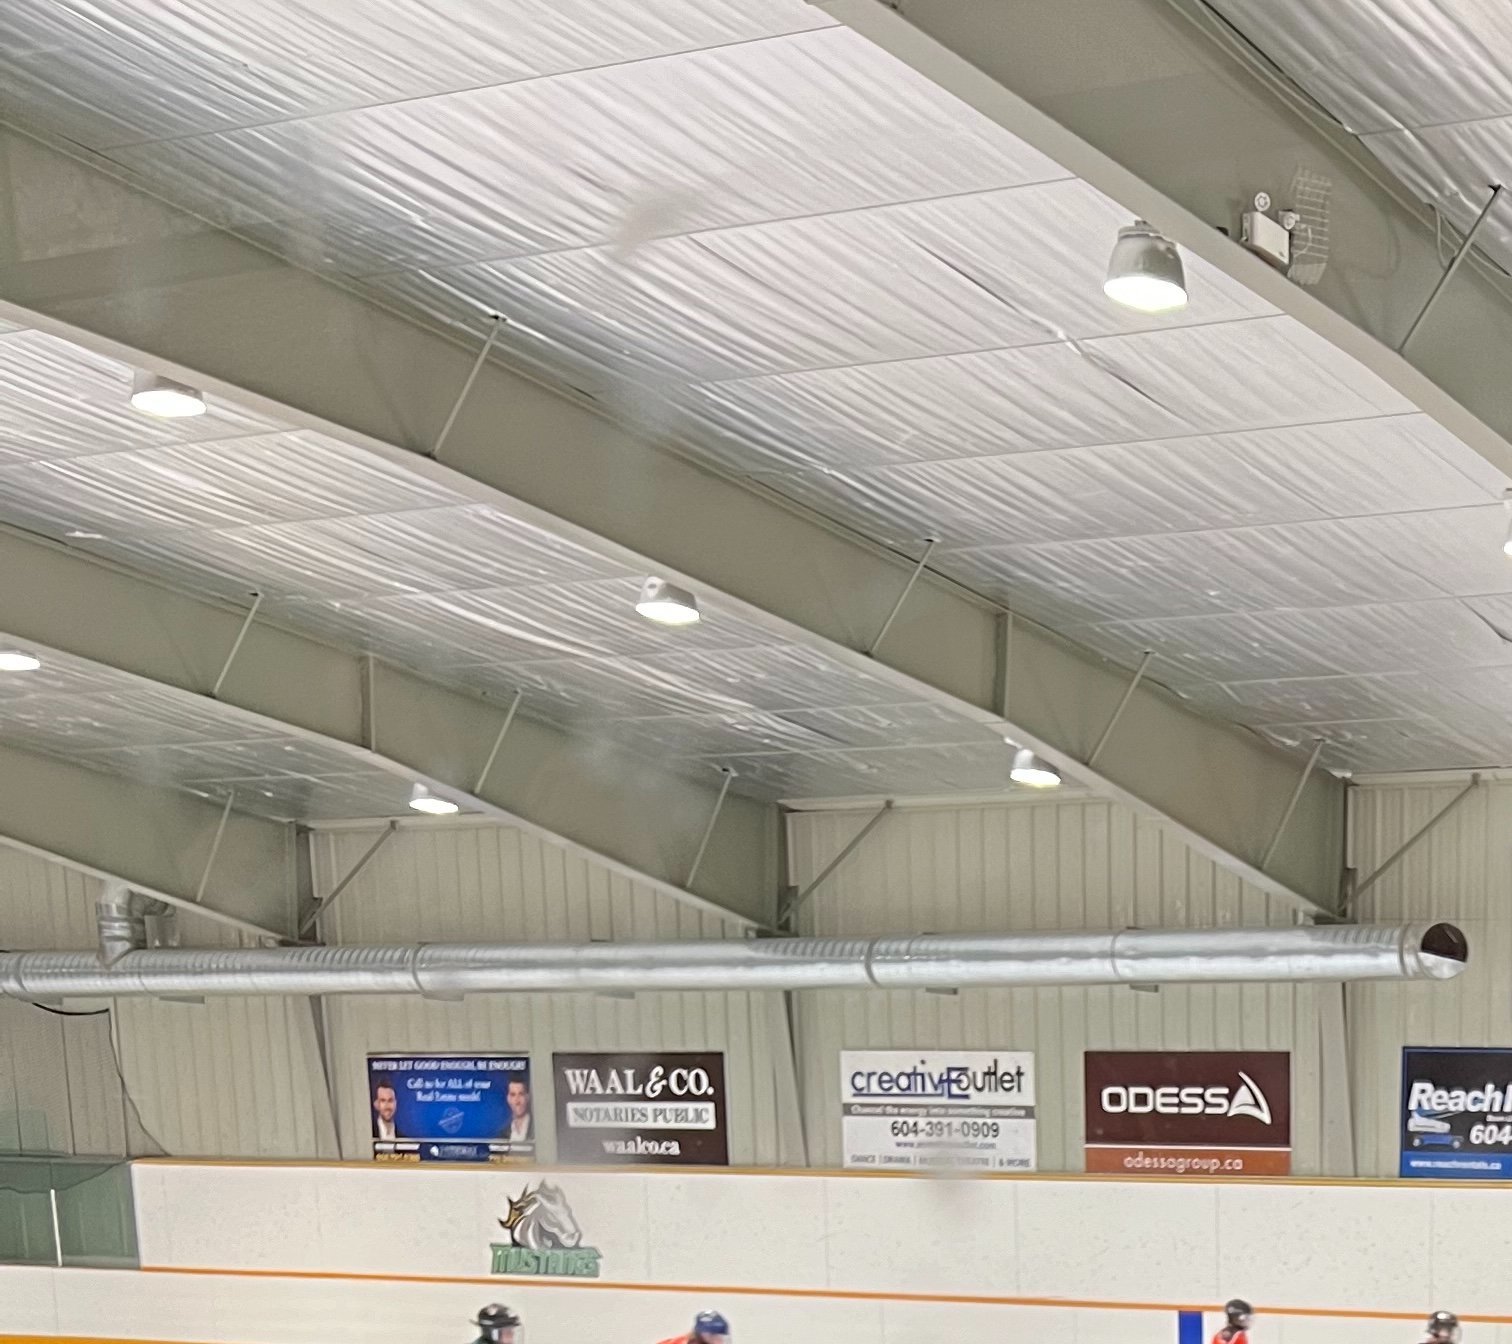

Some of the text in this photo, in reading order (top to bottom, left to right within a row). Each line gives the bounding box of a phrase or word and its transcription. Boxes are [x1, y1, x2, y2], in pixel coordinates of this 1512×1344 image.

[1101, 1071, 1272, 1125] ODESSA
[1408, 1082, 1501, 1113] Reach
[572, 1106, 710, 1124] NOTARIES PUBLIC
[891, 1120, 1000, 1138] 604-391-0909
[602, 1135, 681, 1156] waalco.ca
[1123, 1151, 1243, 1173] odessagroup.ca
